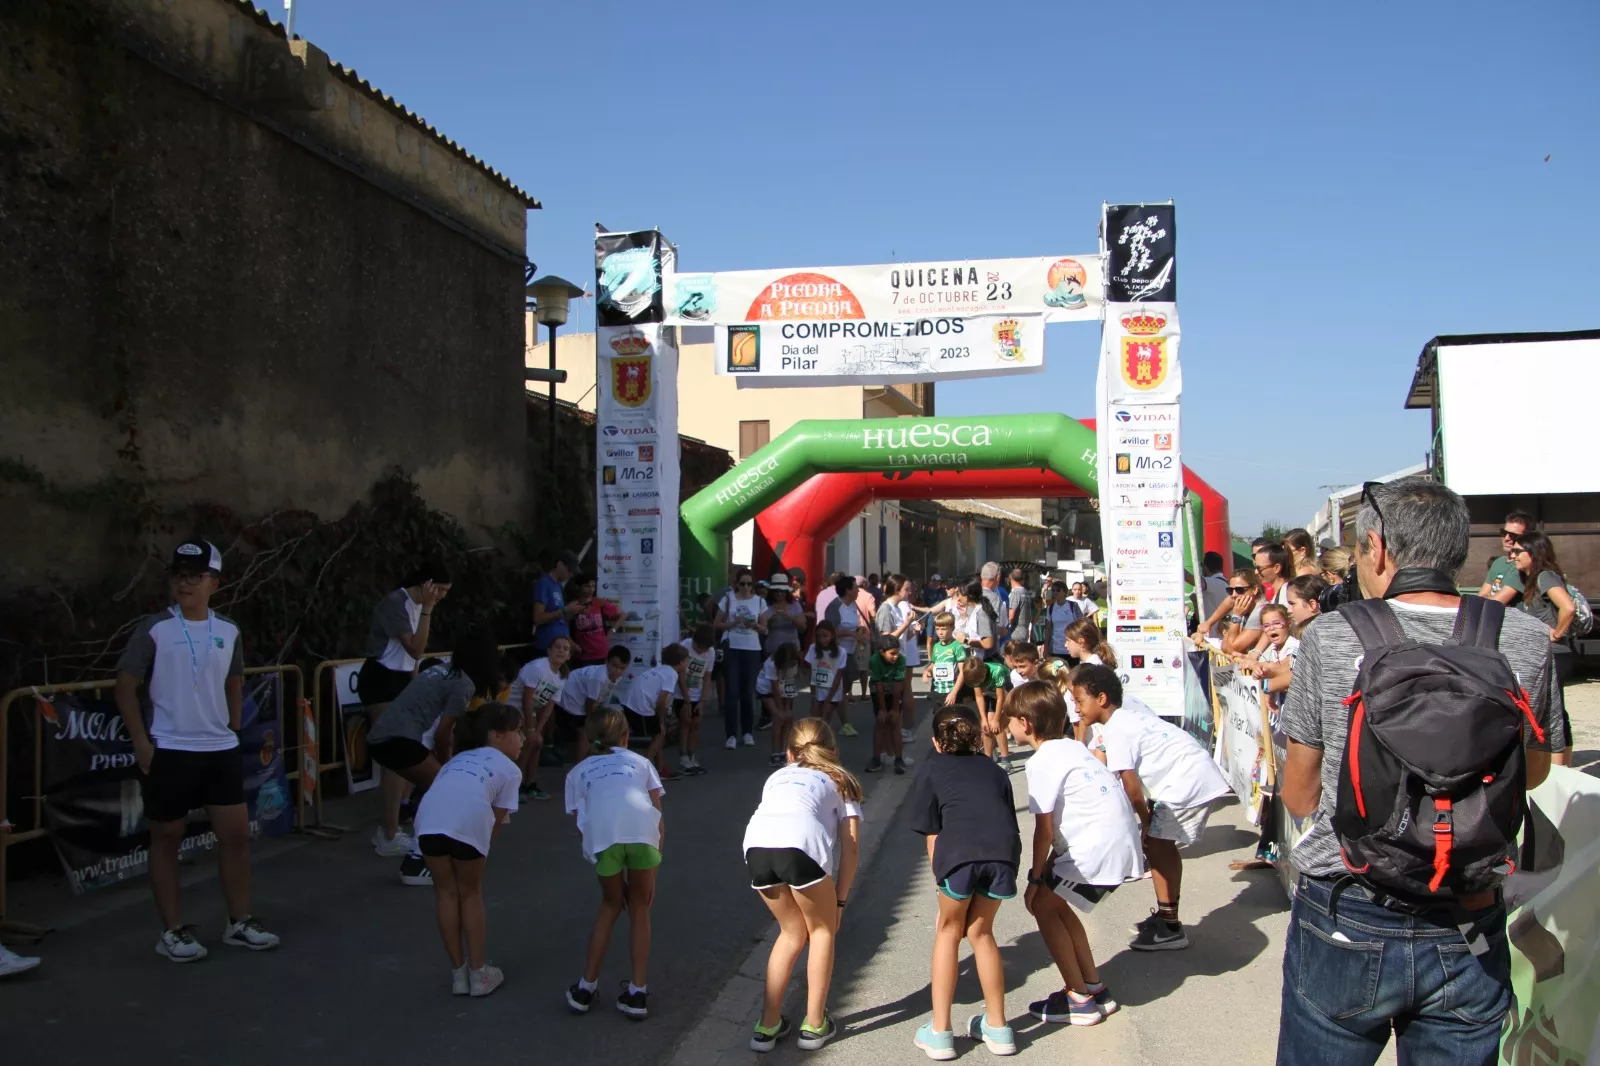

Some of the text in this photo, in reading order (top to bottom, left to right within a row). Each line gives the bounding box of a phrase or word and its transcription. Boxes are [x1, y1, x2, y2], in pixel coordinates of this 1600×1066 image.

[890, 267, 979, 289] QUICENA
[892, 282, 1013, 305] 7 de OCTUBRE 23
[781, 317, 964, 340] COMPROMETIDOS
[802, 344, 819, 355] del
[940, 347, 970, 359] 2023
[782, 357, 818, 370] Pilar
[620, 427, 657, 435] VIDAL
[1117, 548, 1149, 557] fotoprix
